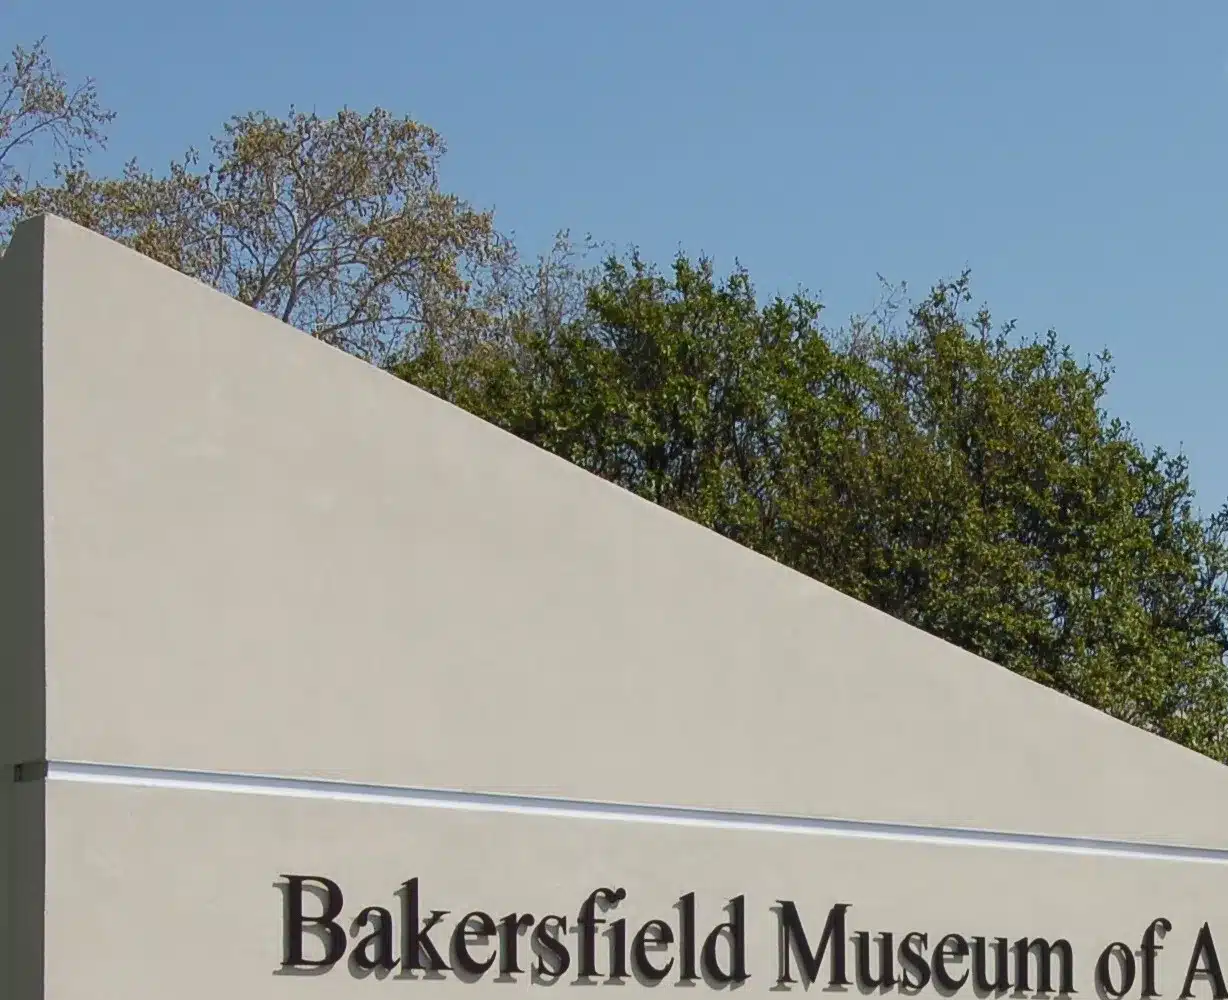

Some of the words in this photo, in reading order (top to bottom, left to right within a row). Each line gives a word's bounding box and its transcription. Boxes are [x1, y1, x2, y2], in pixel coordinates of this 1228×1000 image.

[278, 875, 751, 985] Bakersfield
[775, 900, 1077, 997] Museum
[1098, 918, 1172, 1000] of
